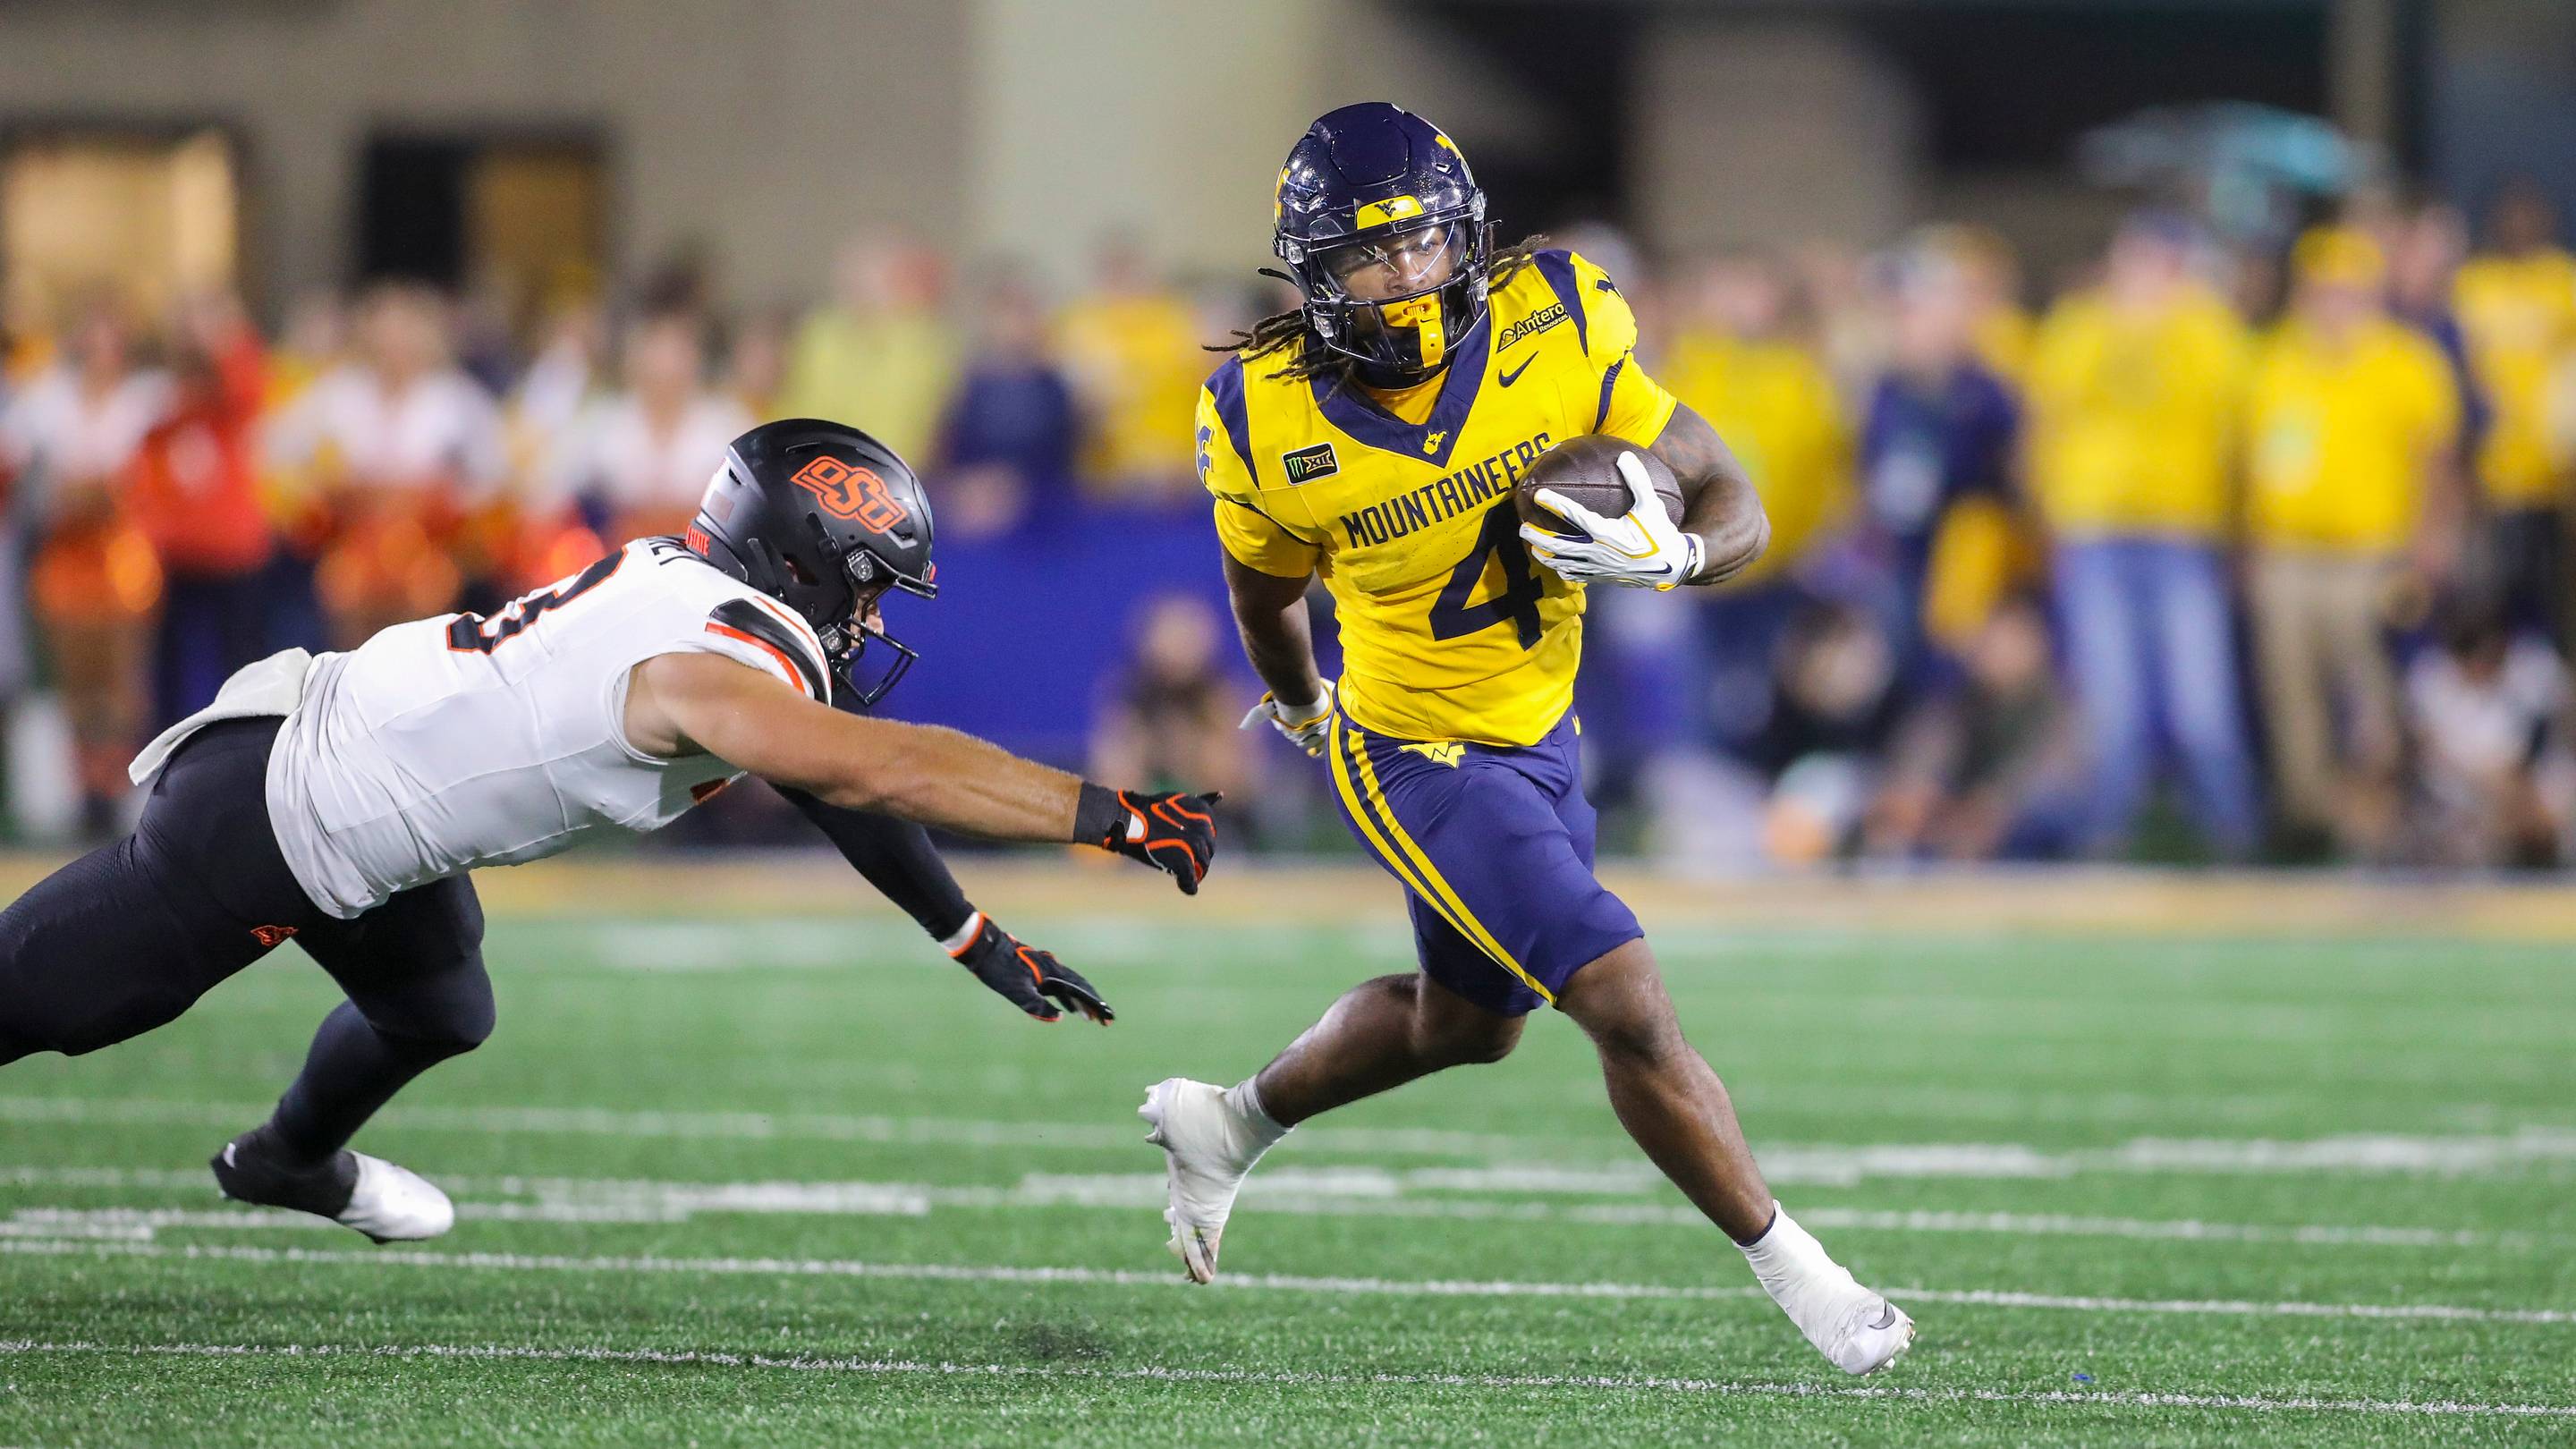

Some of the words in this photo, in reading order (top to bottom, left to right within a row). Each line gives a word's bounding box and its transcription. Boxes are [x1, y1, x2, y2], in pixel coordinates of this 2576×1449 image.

[1514, 301, 1565, 340] Antero
[1538, 314, 1569, 334] Resources
[790, 455, 908, 535] OSU
[1428, 496, 1545, 652] 4
